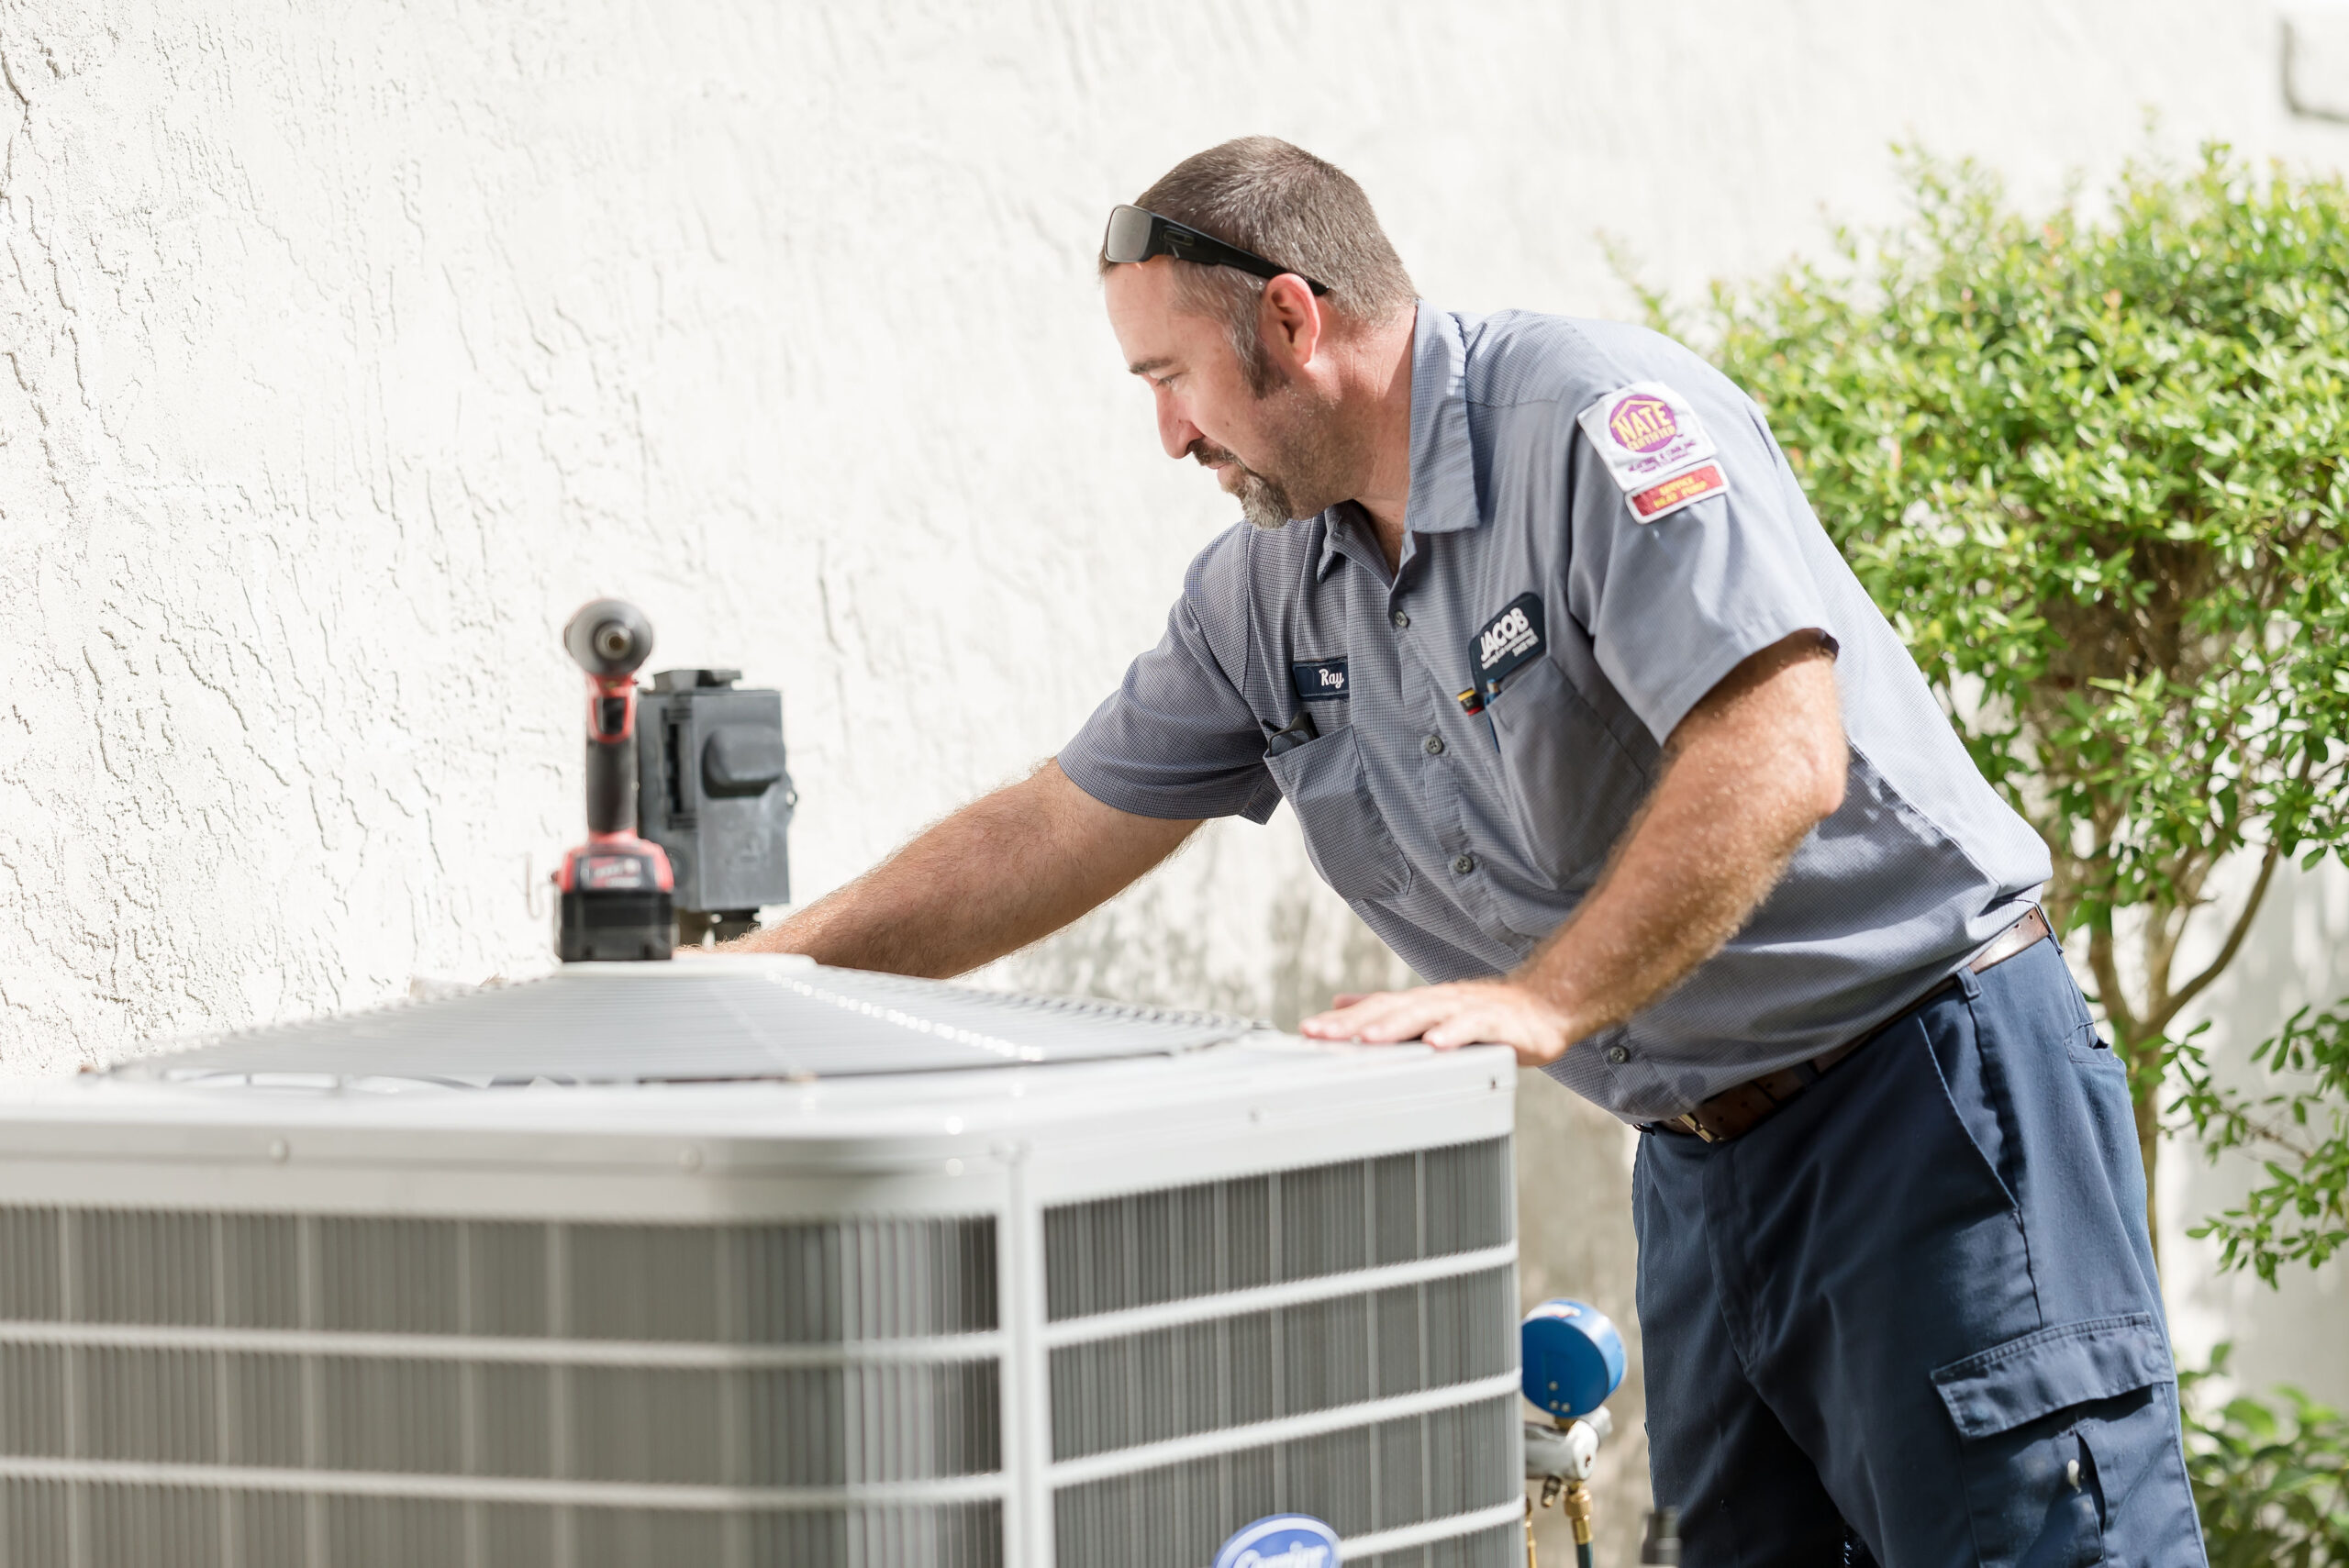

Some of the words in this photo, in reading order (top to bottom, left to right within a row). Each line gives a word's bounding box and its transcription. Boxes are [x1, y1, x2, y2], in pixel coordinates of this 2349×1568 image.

[1610, 401, 1672, 443] NATE
[1480, 606, 1530, 662] JACOB
[1319, 668, 1344, 689] Ray
